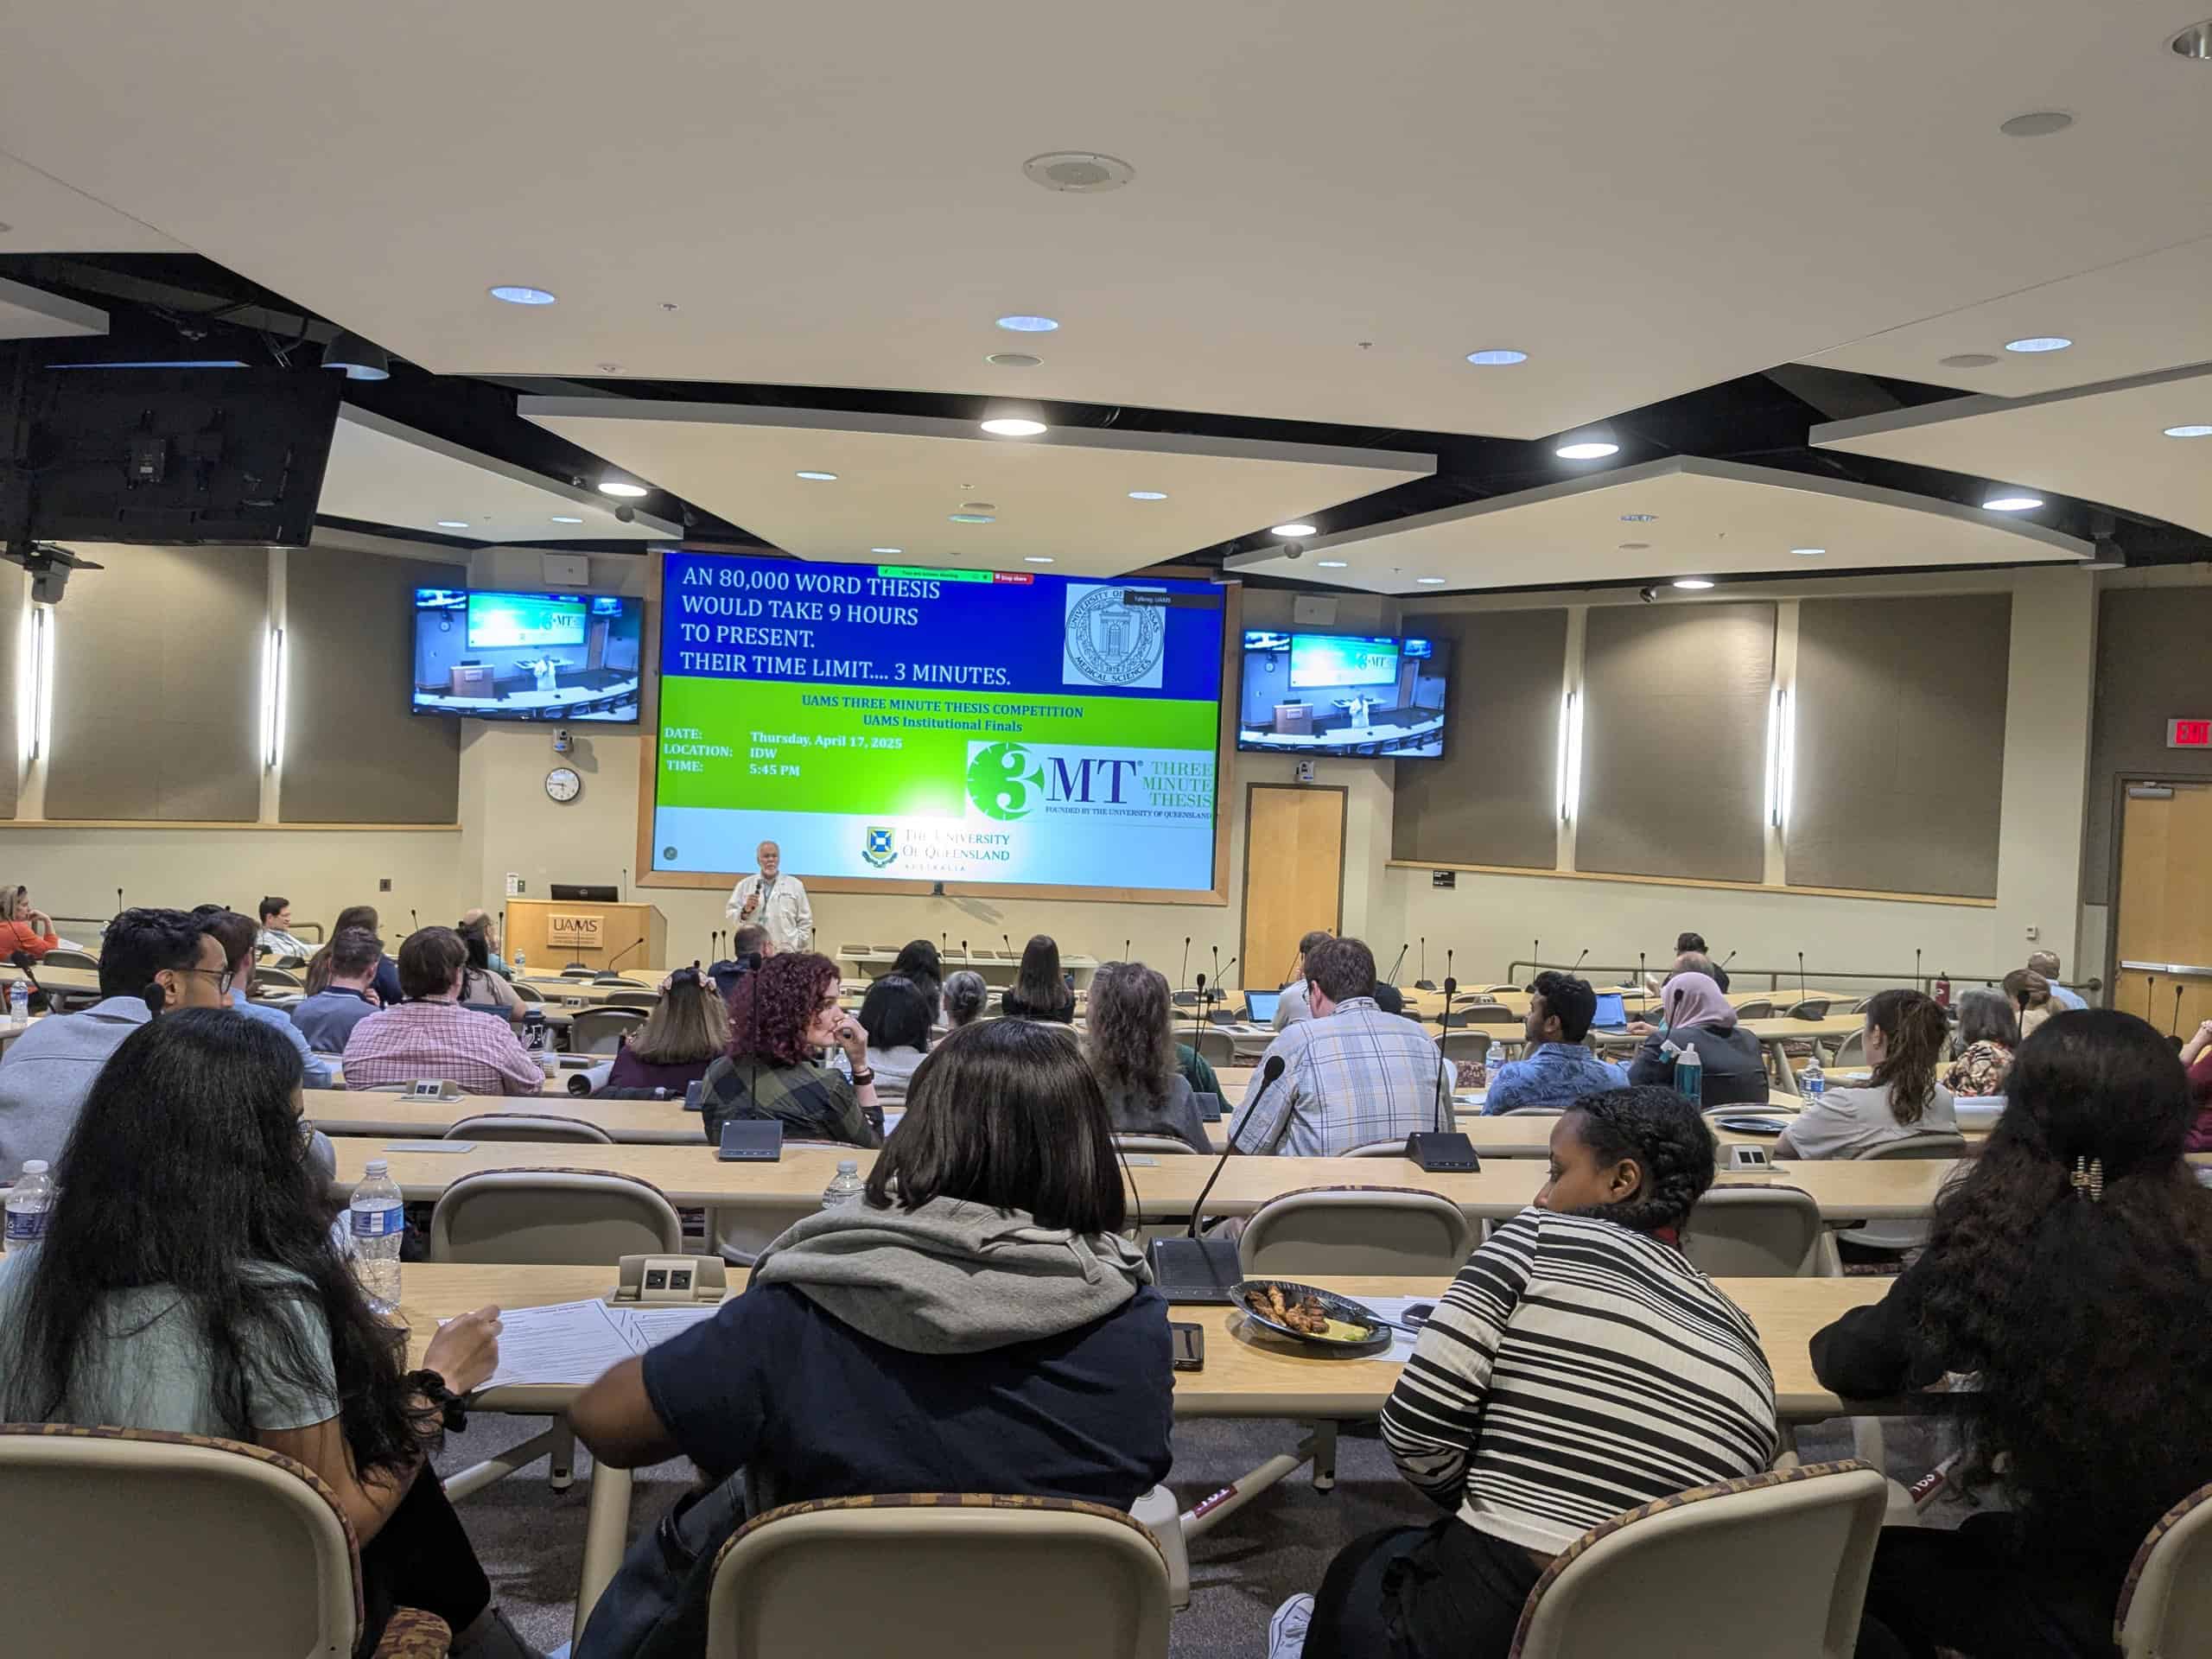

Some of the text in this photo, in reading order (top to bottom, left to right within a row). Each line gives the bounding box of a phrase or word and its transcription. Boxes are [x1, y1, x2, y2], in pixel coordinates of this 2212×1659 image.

[682, 567, 941, 600] AN 80,000 WORD THESIS
[682, 594, 918, 626] WOULD TAKE 9 HOURS
[681, 623, 815, 648] TO PRESENT.
[680, 652, 1011, 686] THEIR TIME LIMIT.... 3 MINUTES.
[1075, 656, 1107, 682] MEDICAL
[802, 694, 1084, 718] UAMS THREE MINUTE THESIS COMPETITION
[863, 715, 1023, 733] UAMS Institutional Finals
[2177, 721, 2210, 744] EXIT
[664, 727, 903, 750] DATE: Thursday, April 17, 2025
[664, 743, 778, 760] LOCATION: IDW
[666, 759, 801, 777] TIME: 5:45 PM
[1151, 760, 1213, 777] THREE
[1141, 775, 1213, 792] MINUTE
[1149, 791, 1212, 808] THESIS
[1046, 805, 1080, 815] FOUNDED
[1081, 807, 1091, 816] BY
[1092, 808, 1107, 817] THE
[1108, 809, 1153, 817] UNIVERSITY
[553, 918, 598, 933] UAMS
